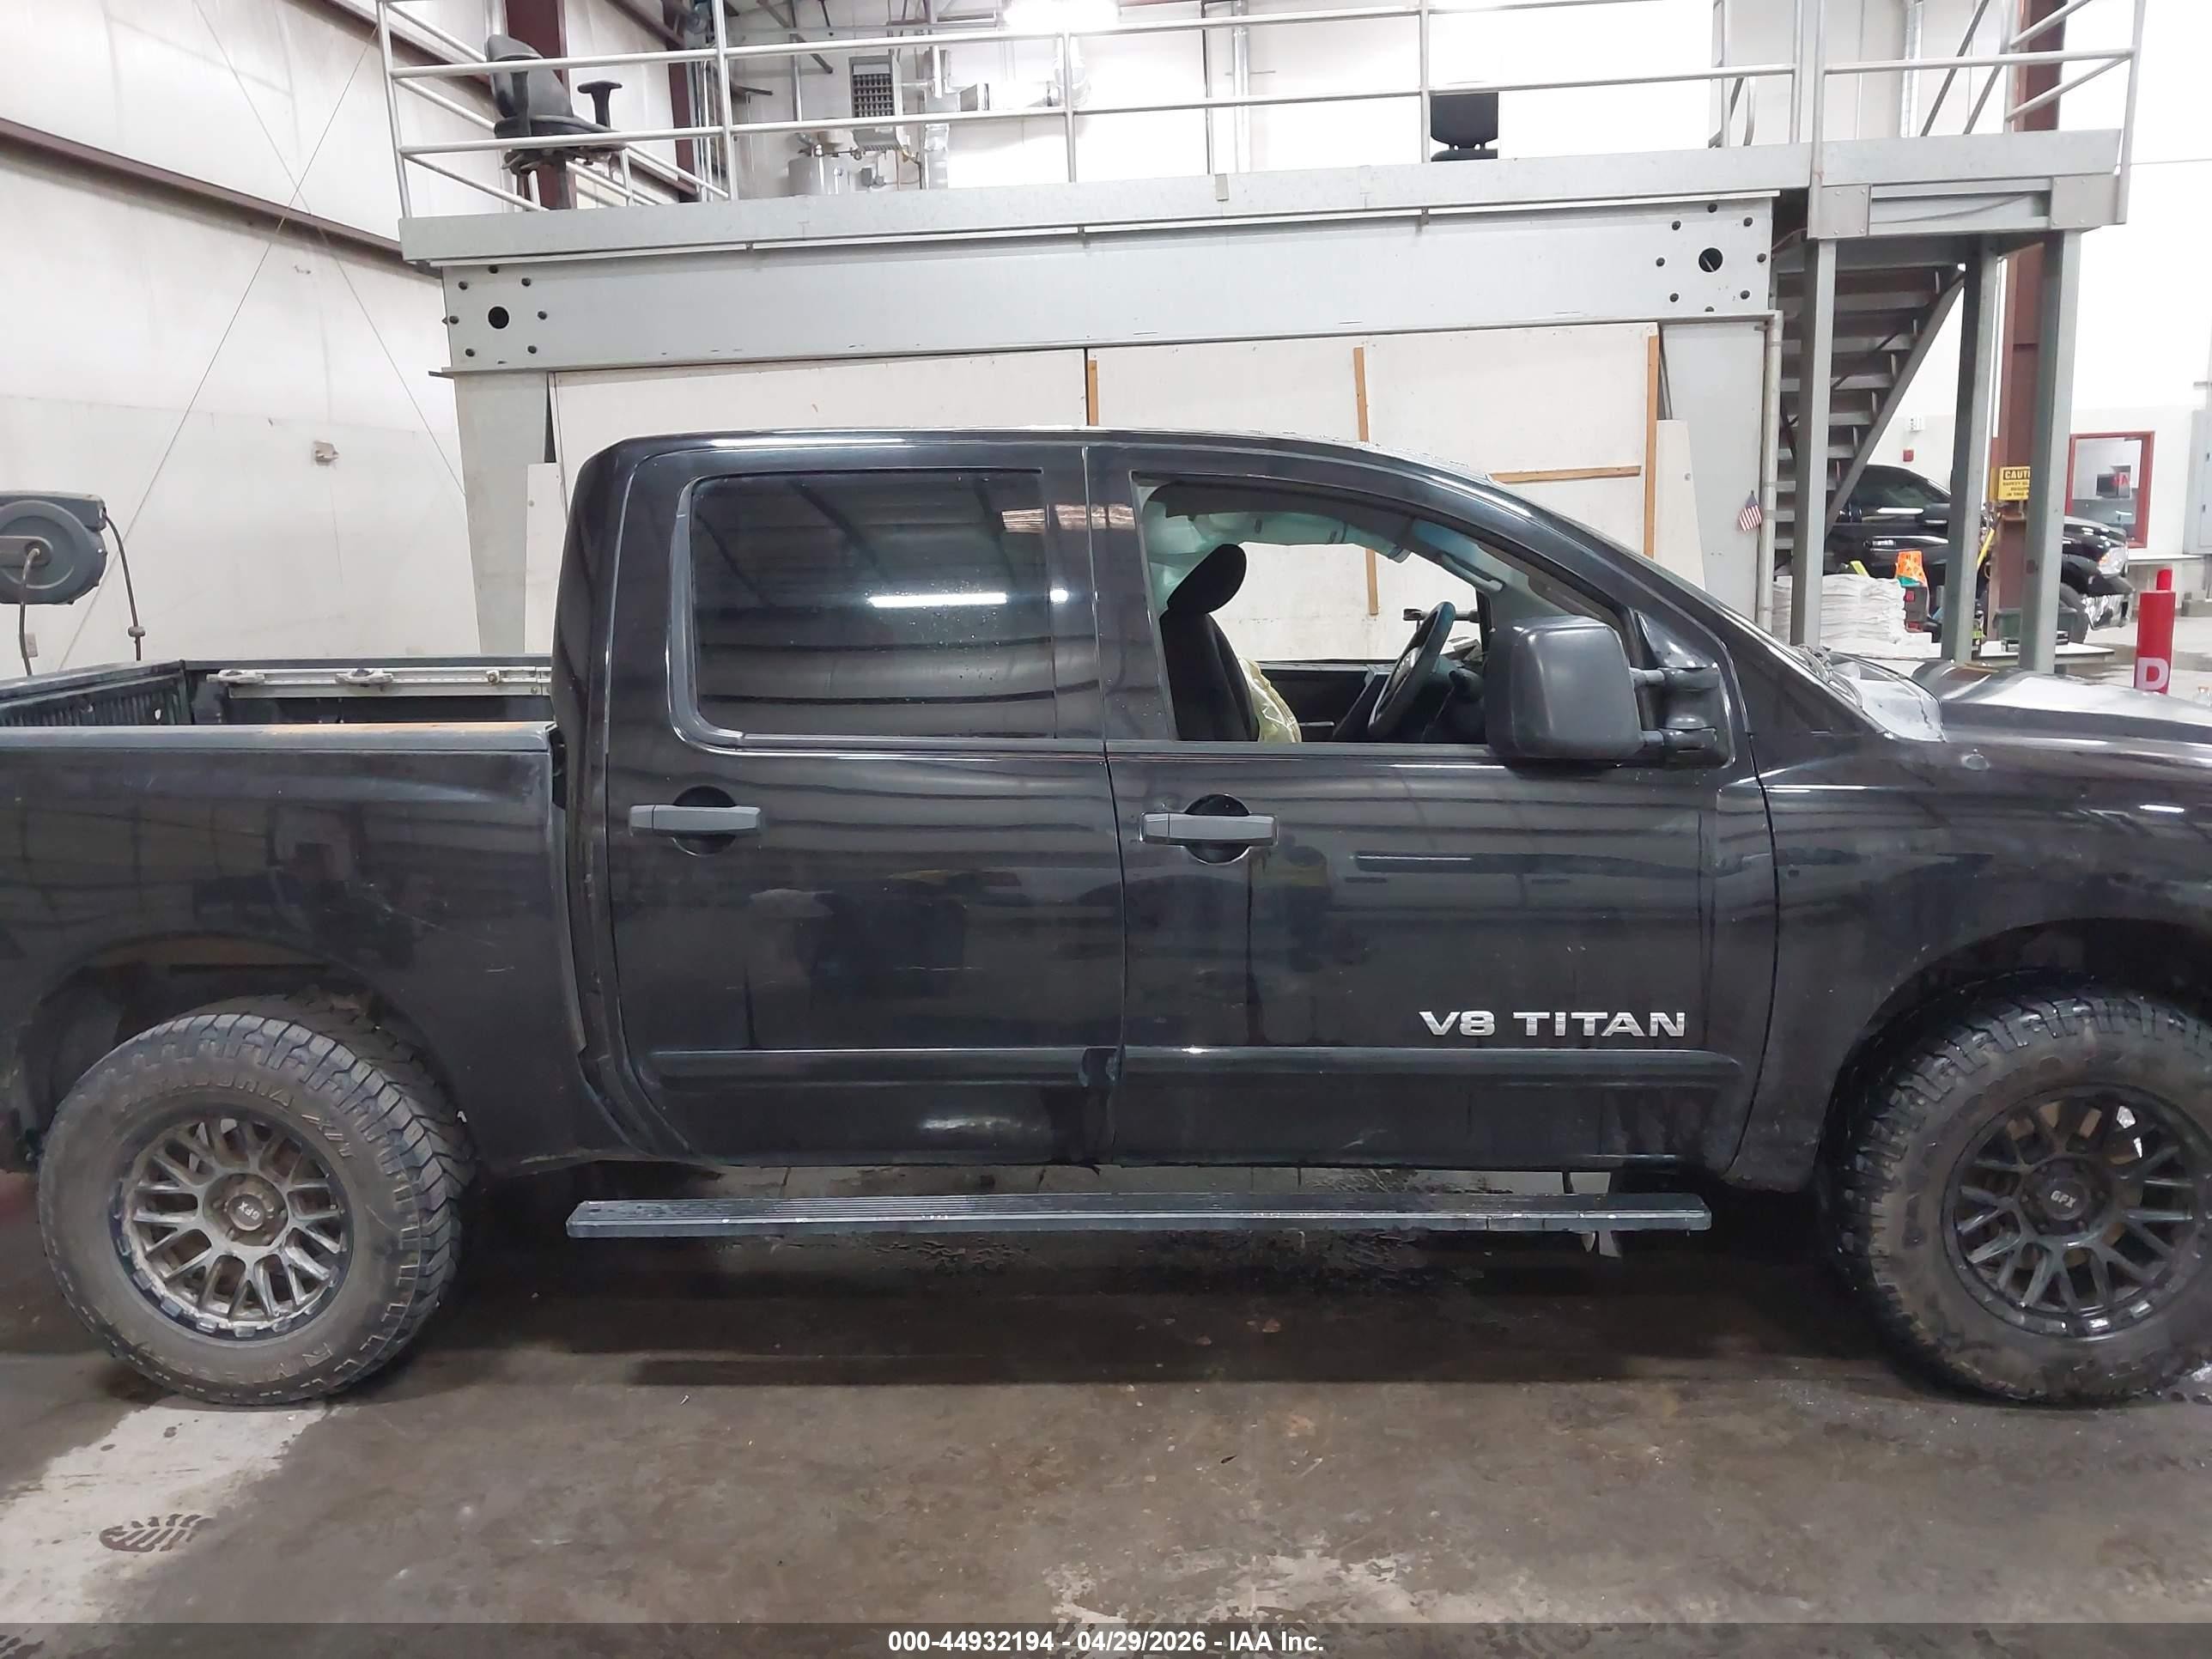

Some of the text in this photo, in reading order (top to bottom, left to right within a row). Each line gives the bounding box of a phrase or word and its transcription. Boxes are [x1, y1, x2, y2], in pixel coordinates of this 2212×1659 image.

[2004, 470, 2031, 479] CAUTI
[2136, 658, 2169, 690] D
[1419, 1011, 1686, 1036] V8 TITAN
[2051, 1190, 2076, 1208] GFX
